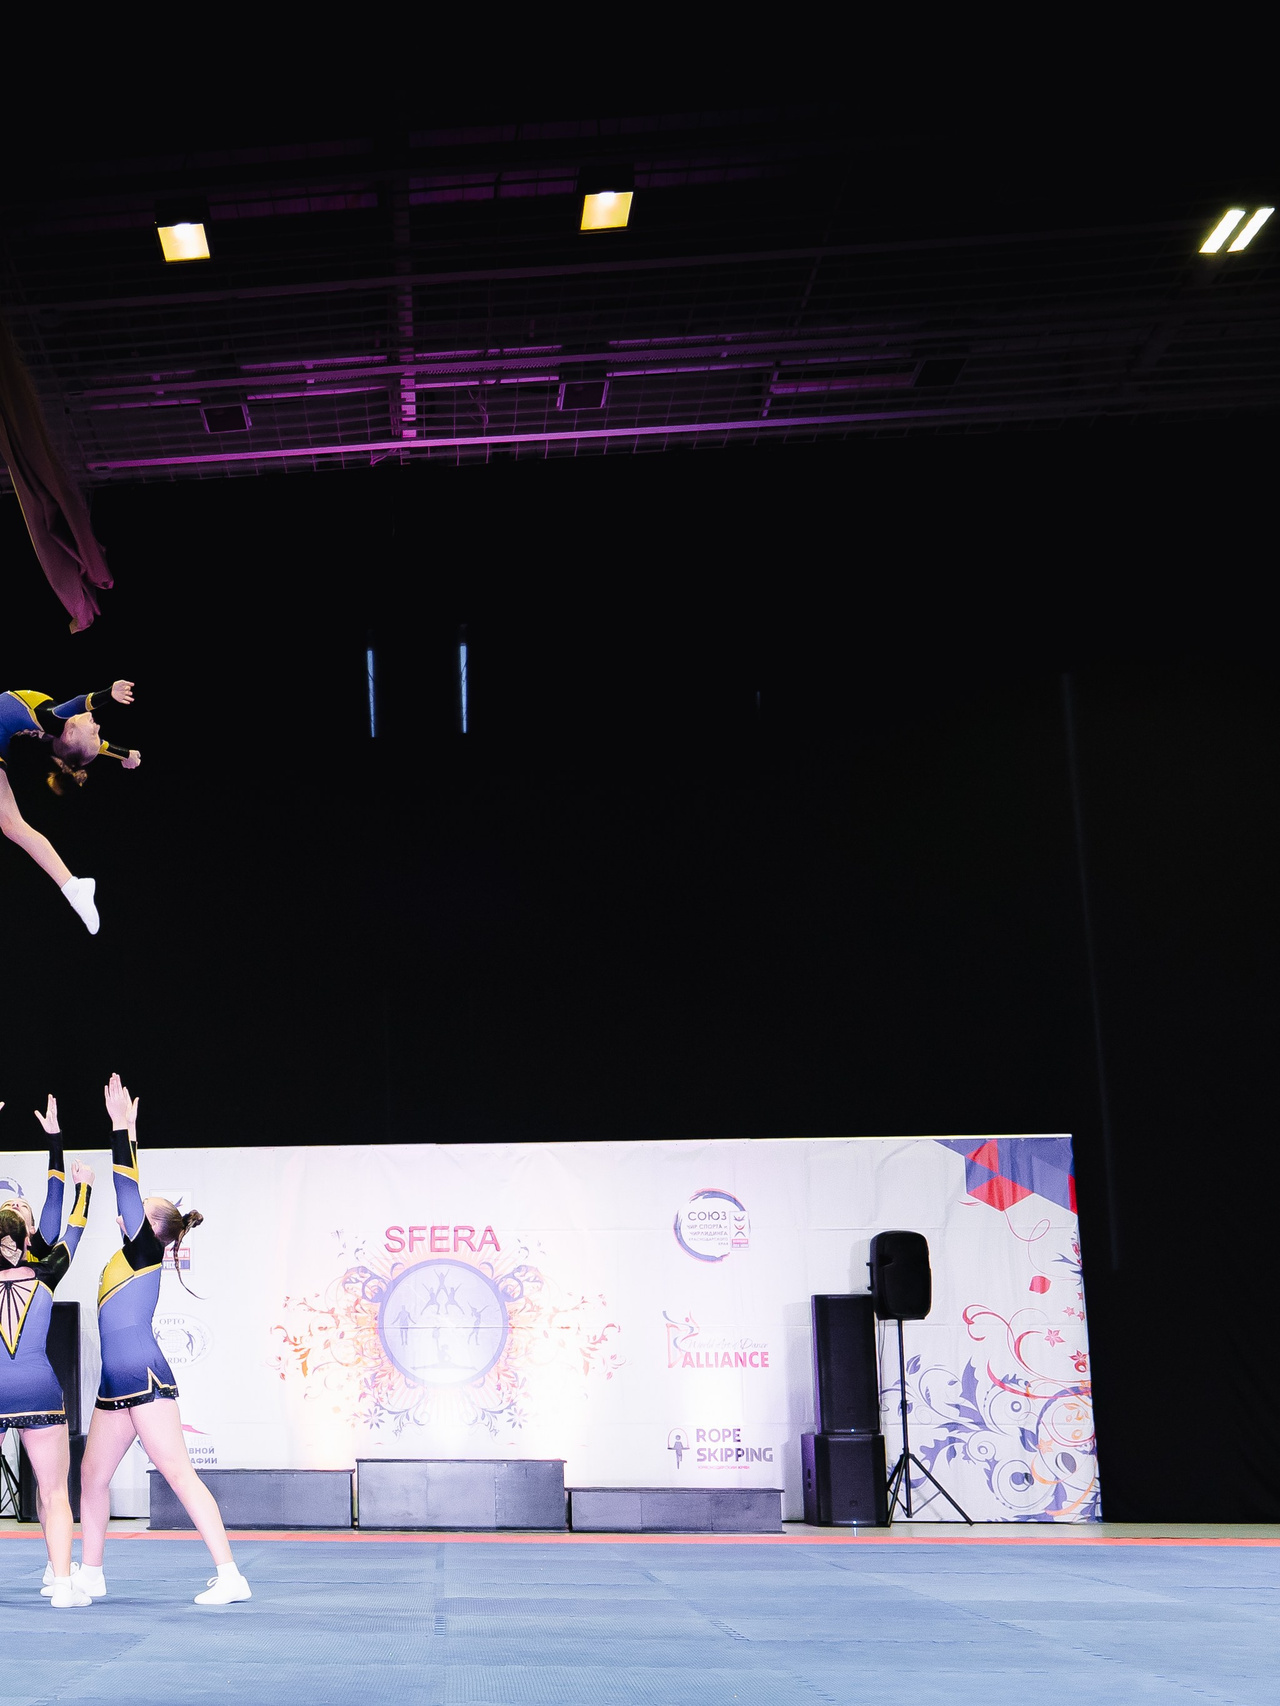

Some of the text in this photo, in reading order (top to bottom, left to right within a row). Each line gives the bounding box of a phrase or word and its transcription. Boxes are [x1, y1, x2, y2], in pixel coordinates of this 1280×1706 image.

[688, 1211, 727, 1221] СОЮЗ
[384, 1225, 501, 1253] SFERA
[682, 1352, 769, 1368] ALLIANCE
[696, 1428, 741, 1442] ROPE
[697, 1448, 773, 1462] SKIPPING
